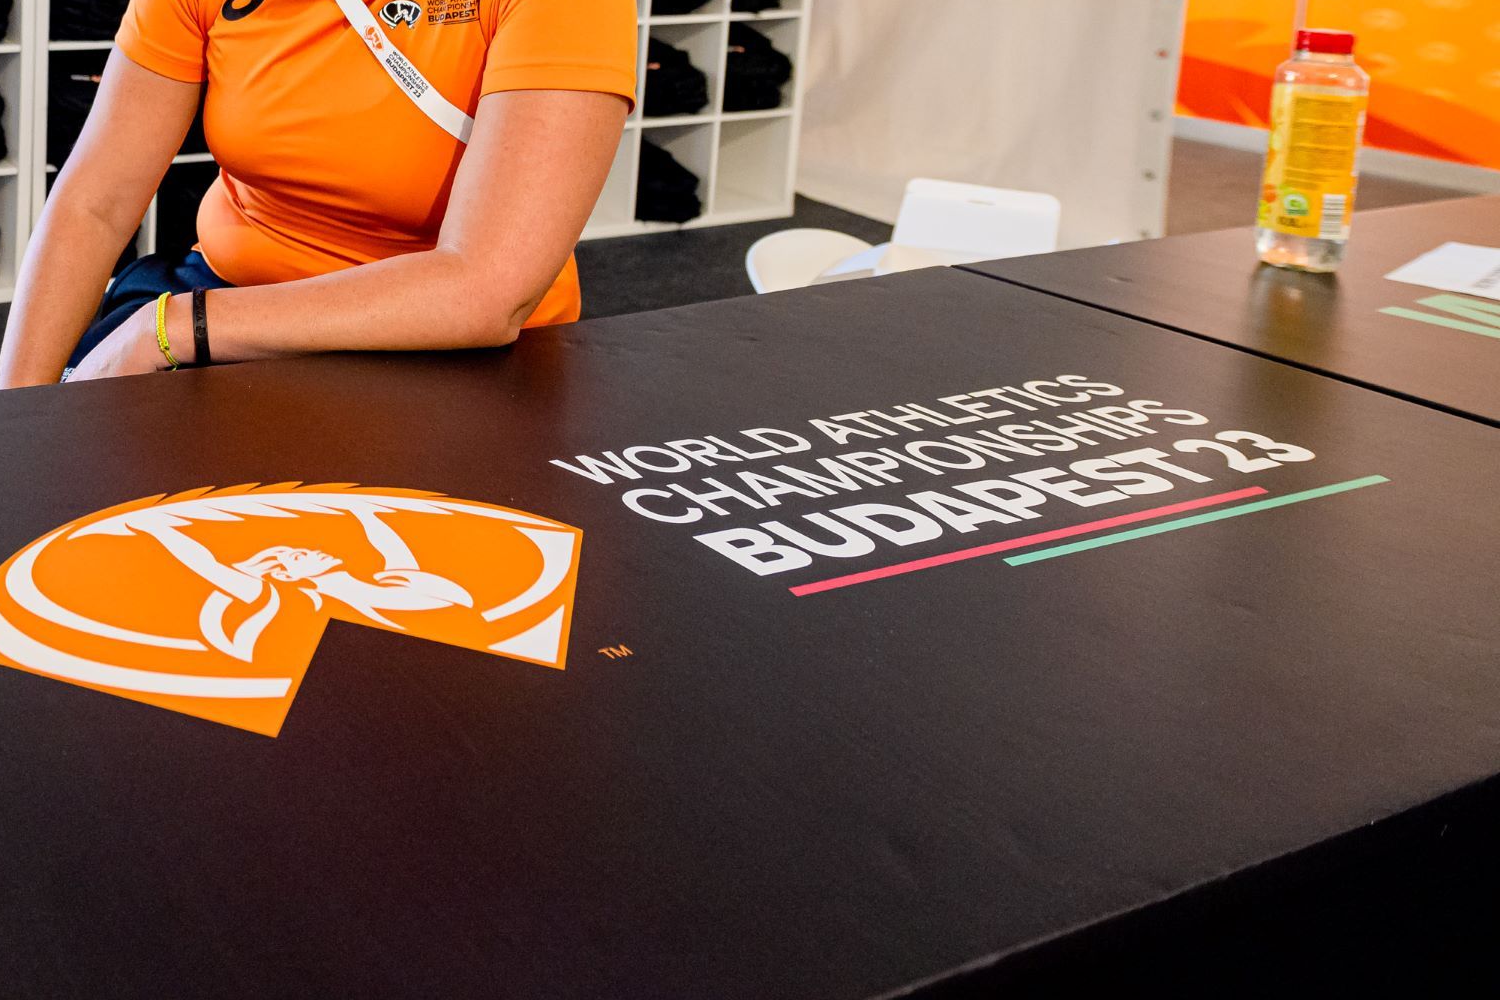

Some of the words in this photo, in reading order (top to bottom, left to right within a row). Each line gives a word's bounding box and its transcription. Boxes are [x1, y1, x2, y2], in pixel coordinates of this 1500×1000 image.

[428, 9, 476, 23] BUDAPEST
[386, 58, 414, 90] BUDAPEST
[389, 53, 425, 94] CHAMPIONSHIPS
[548, 427, 812, 484] WORLD
[808, 374, 1125, 445] ATHLETICS
[621, 399, 1209, 524] CHAMPIONSHIPS
[692, 447, 1213, 576] BUDAPEST
[1172, 430, 1316, 473] 23
